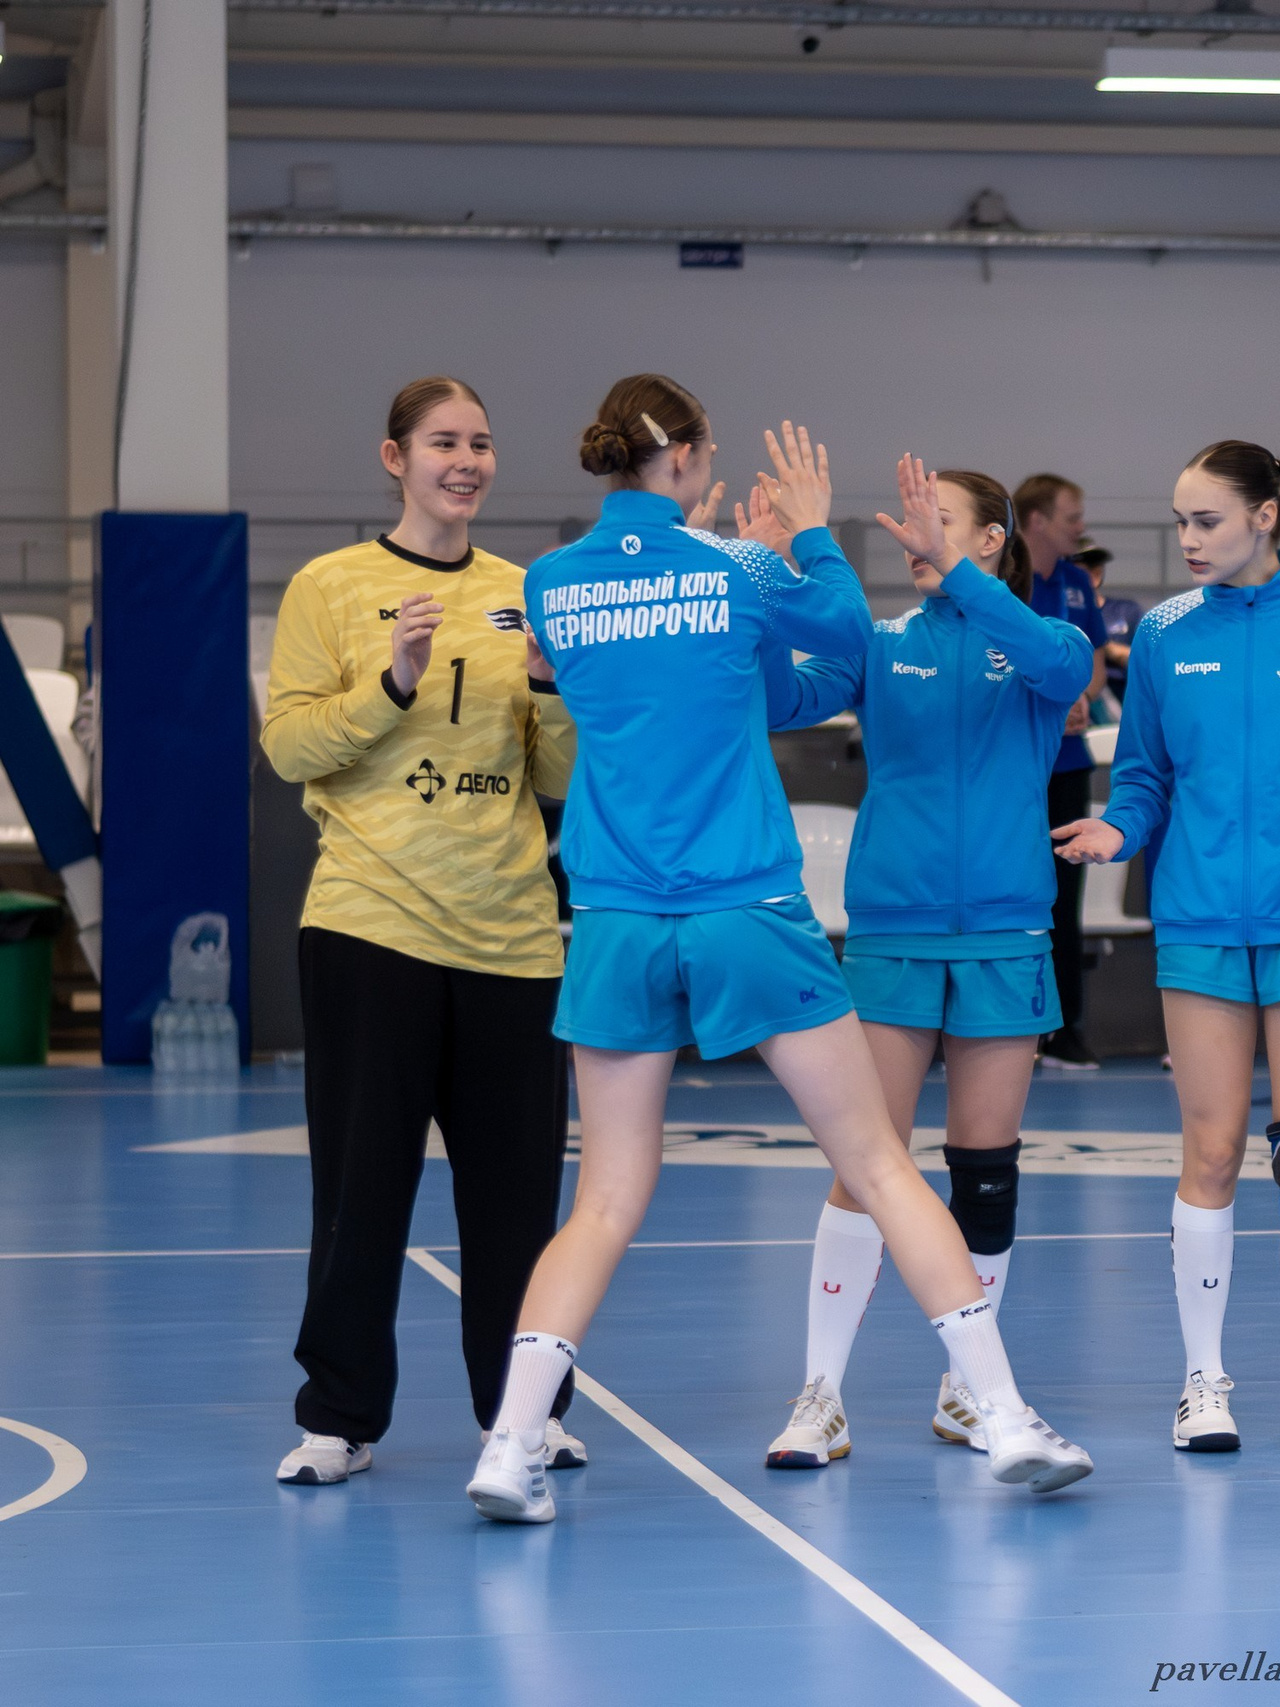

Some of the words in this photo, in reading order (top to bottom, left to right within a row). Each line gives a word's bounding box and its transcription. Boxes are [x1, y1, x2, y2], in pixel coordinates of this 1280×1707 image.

[543, 570, 675, 616] ГАНДБОЛЬНЫЙ
[679, 571, 730, 598] КЛУБ
[545, 600, 730, 651] ЧЕРНОМОРОЧКА
[892, 661, 938, 680] Kempa
[1174, 661, 1221, 676] Kempa
[450, 657, 468, 725] 1
[455, 772, 511, 796] ДЕЛО
